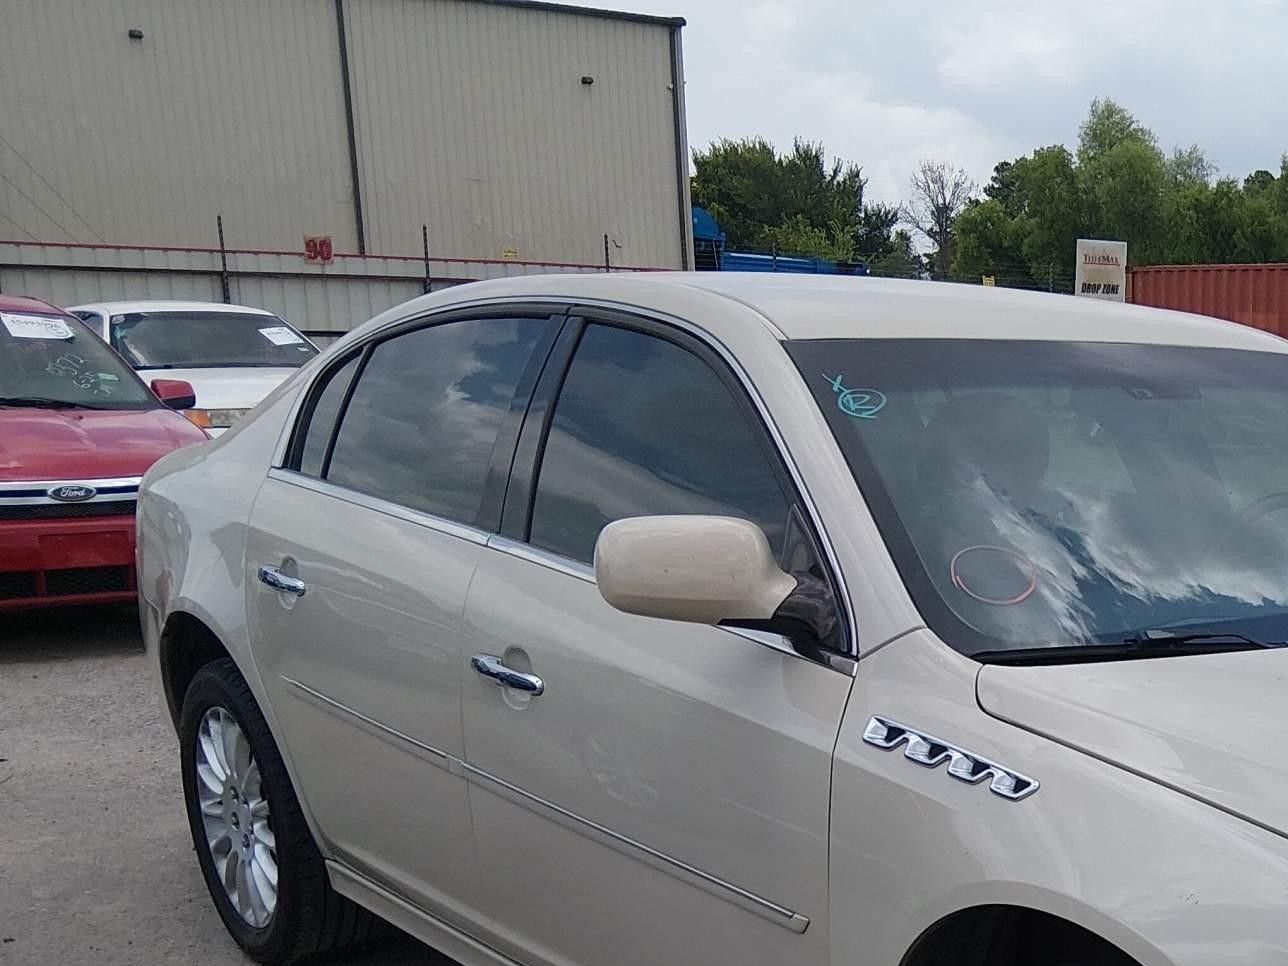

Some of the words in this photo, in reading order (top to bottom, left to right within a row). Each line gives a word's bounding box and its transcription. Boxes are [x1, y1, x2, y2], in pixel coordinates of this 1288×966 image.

[1081, 282, 1102, 294] DROP
[1102, 283, 1120, 294] ZONE
[60, 488, 86, 497] Ford
